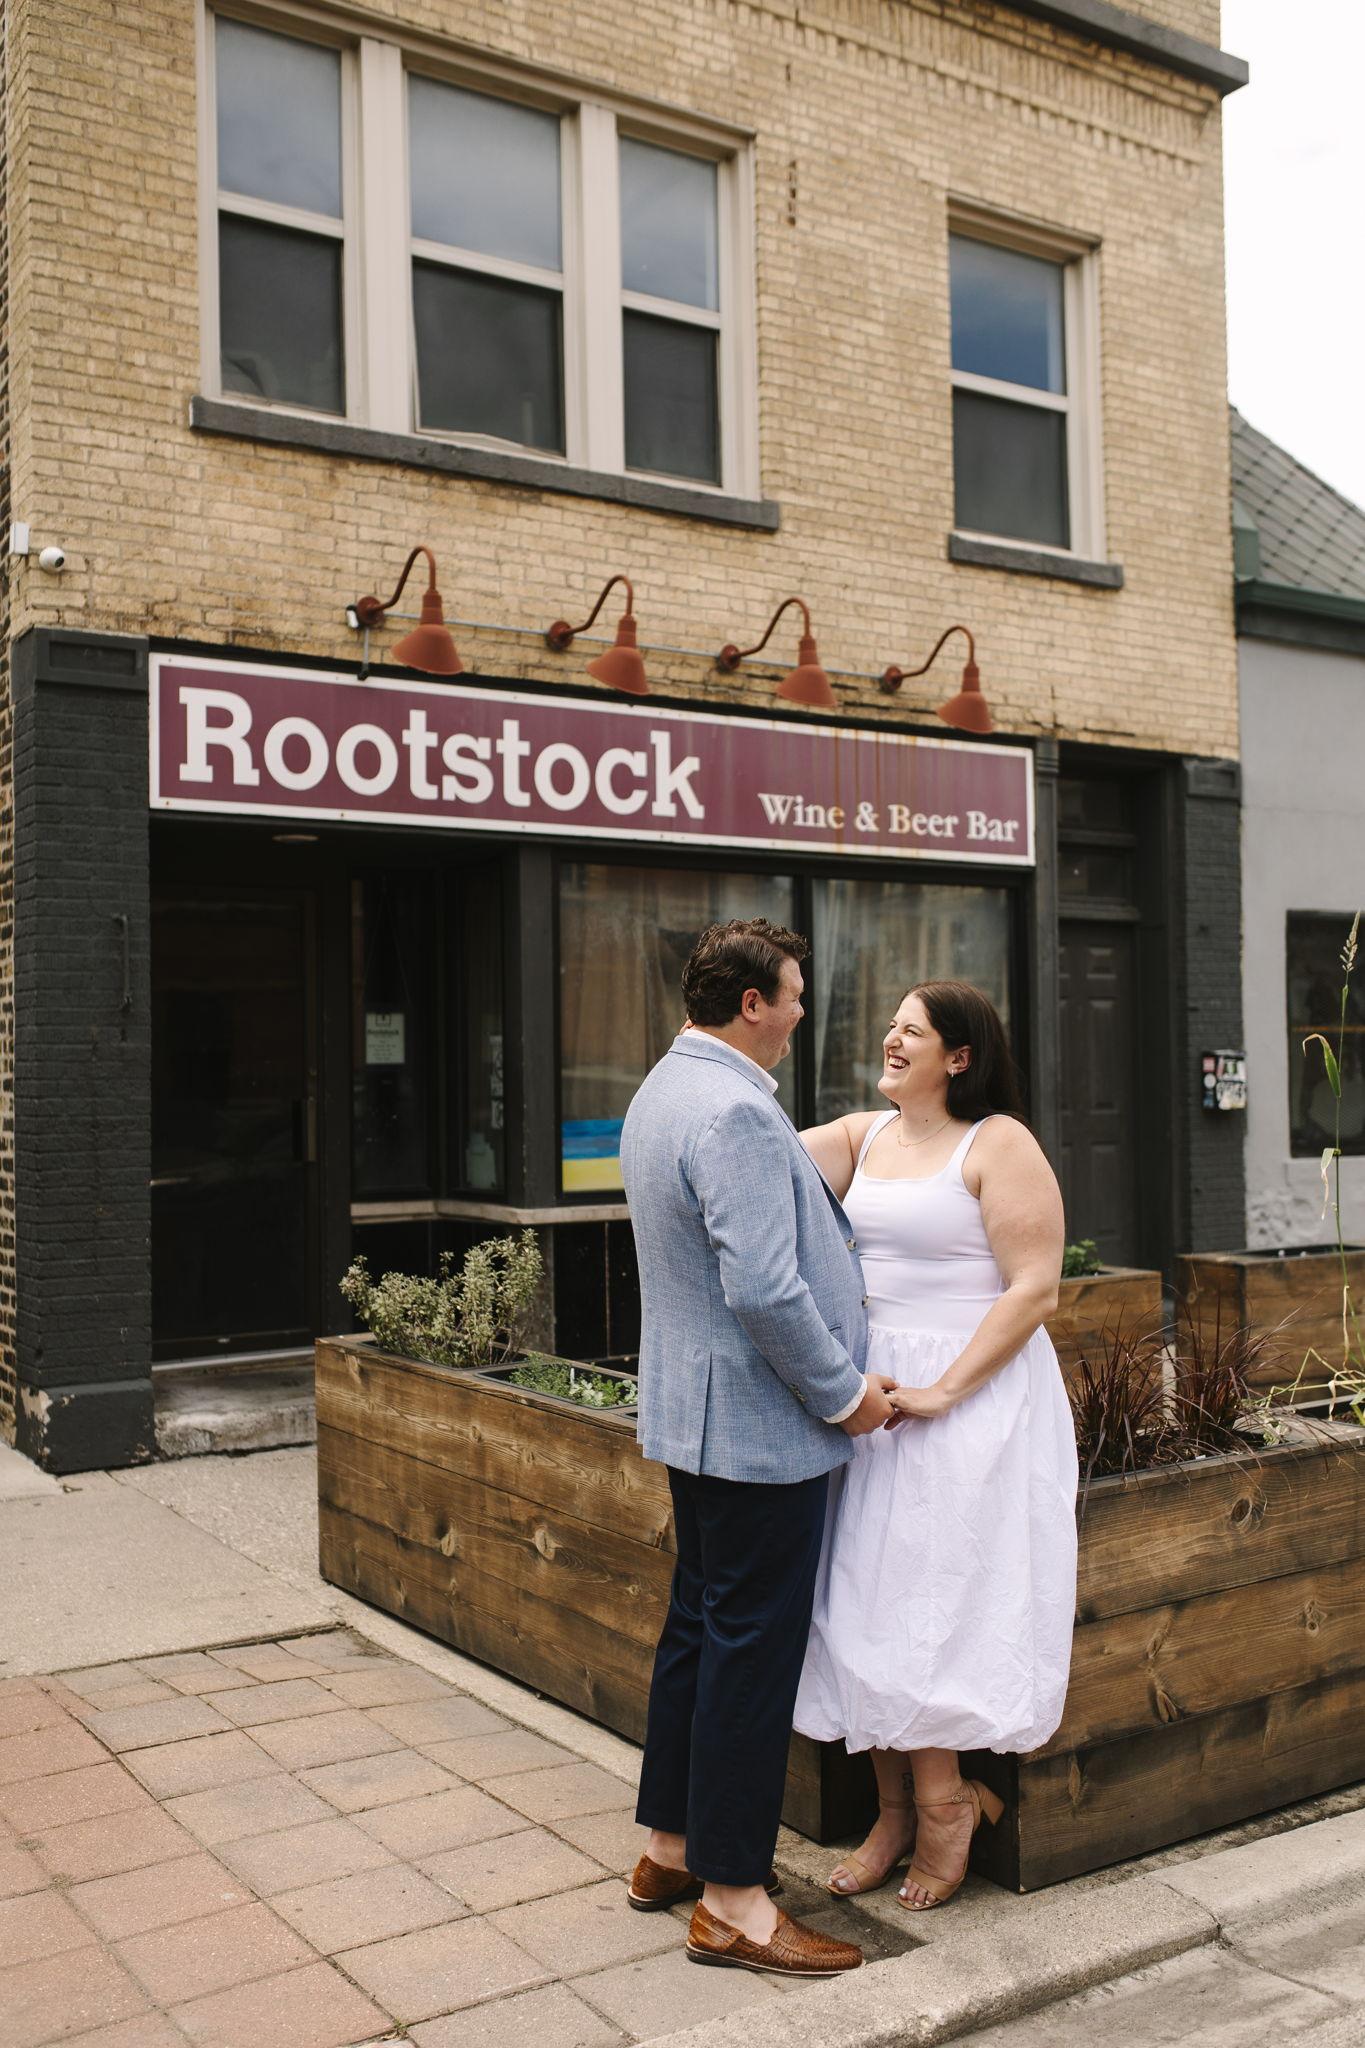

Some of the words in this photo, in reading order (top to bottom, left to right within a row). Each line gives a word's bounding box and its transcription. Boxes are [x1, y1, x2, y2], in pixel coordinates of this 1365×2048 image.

[178, 686, 705, 819] Rootstock
[758, 793, 845, 829] Wine
[854, 801, 879, 832] &
[888, 804, 959, 838] Beer
[966, 811, 1019, 842] Bar
